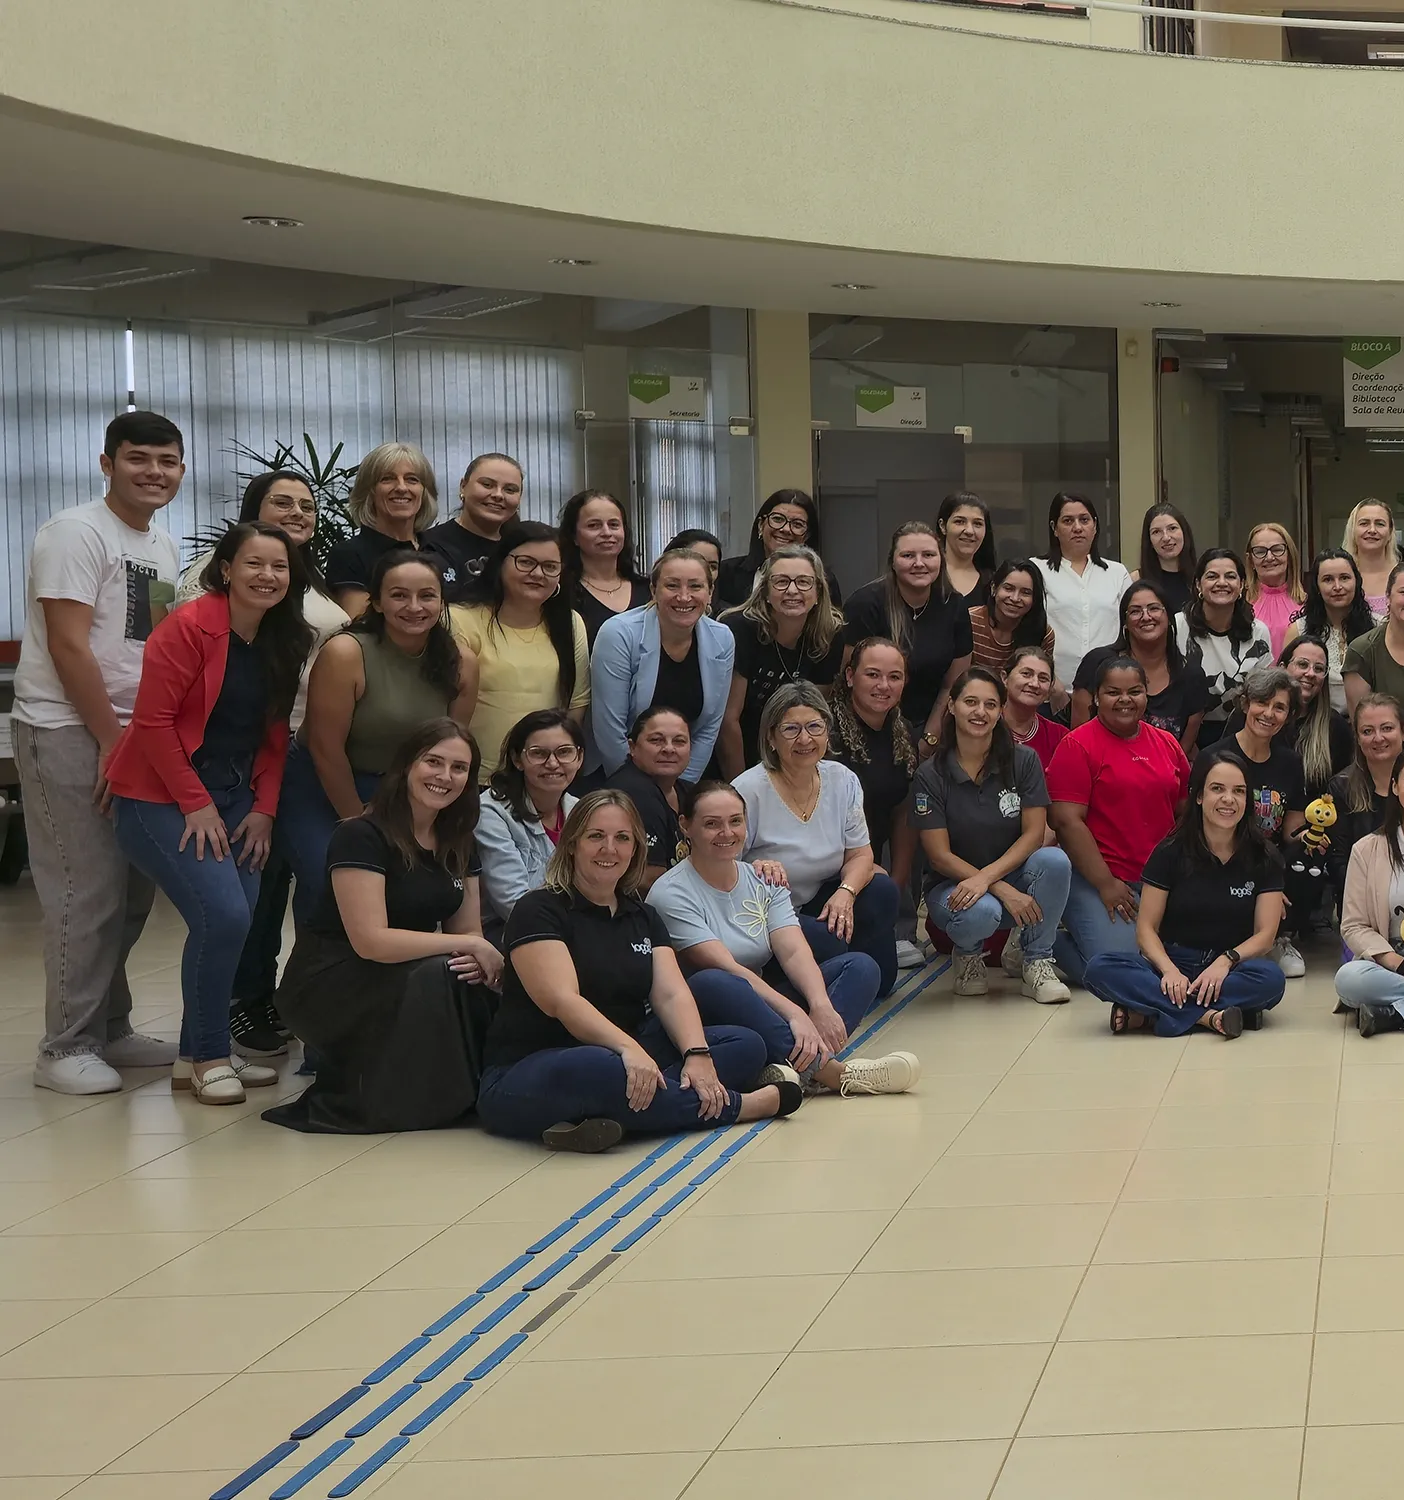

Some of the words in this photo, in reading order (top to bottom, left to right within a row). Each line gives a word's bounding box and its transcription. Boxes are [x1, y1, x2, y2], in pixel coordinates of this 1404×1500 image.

[1351, 342, 1383, 351] BLOCO
[1384, 343, 1391, 351] A
[1352, 371, 1385, 382] Direção
[1352, 394, 1396, 402] Biblioteca
[669, 409, 700, 418] Secretaria
[1352, 405, 1372, 414] Sala
[1374, 405, 1384, 414] de
[1230, 886, 1252, 898] logos
